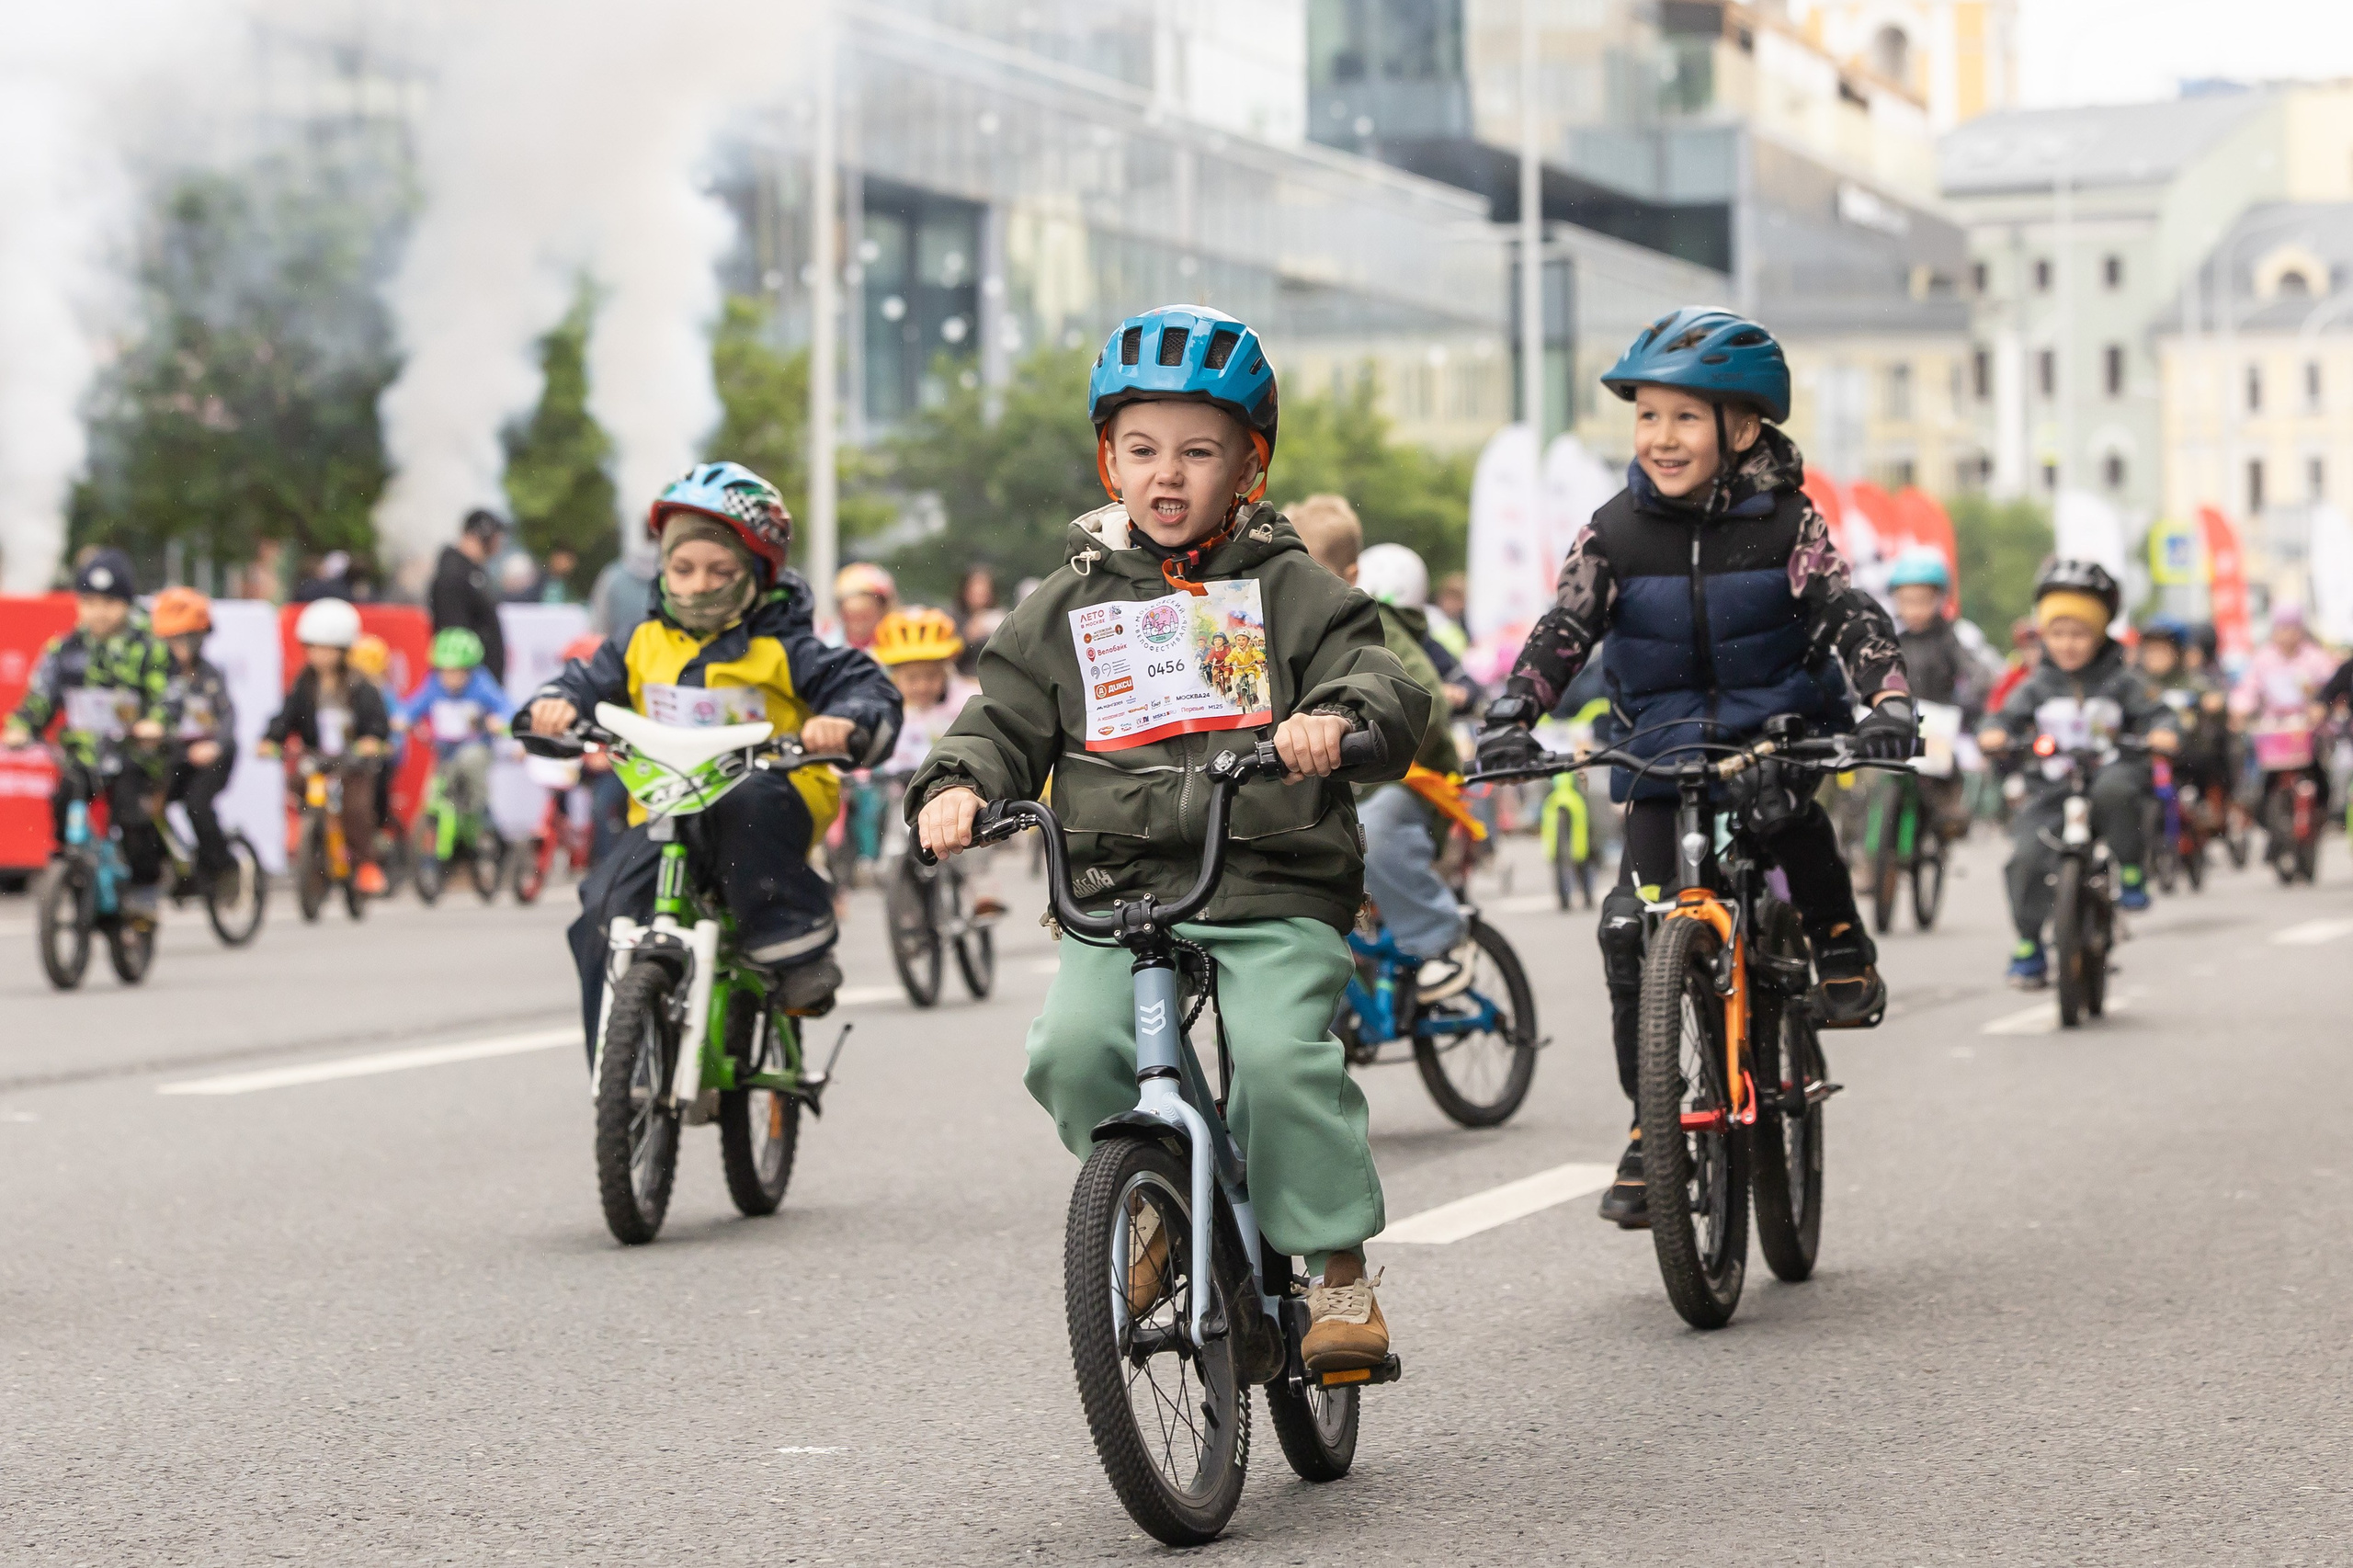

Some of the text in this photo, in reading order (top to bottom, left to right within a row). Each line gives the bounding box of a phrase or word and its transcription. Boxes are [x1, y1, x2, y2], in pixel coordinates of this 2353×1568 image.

[1080, 609, 1105, 623] ЛЕТО
[1135, 598, 1186, 622] МОСКОВСКИЙ
[1086, 619, 1106, 628] МОСКВЕ
[1135, 620, 1188, 653] ВЕЛОФЕСТИВАЛЬ
[1097, 643, 1128, 656] Велобайк
[1147, 658, 1186, 677] 0456
[1176, 692, 1211, 701] МОСКВА24
[1234, 1389, 1245, 1467] KENDA
